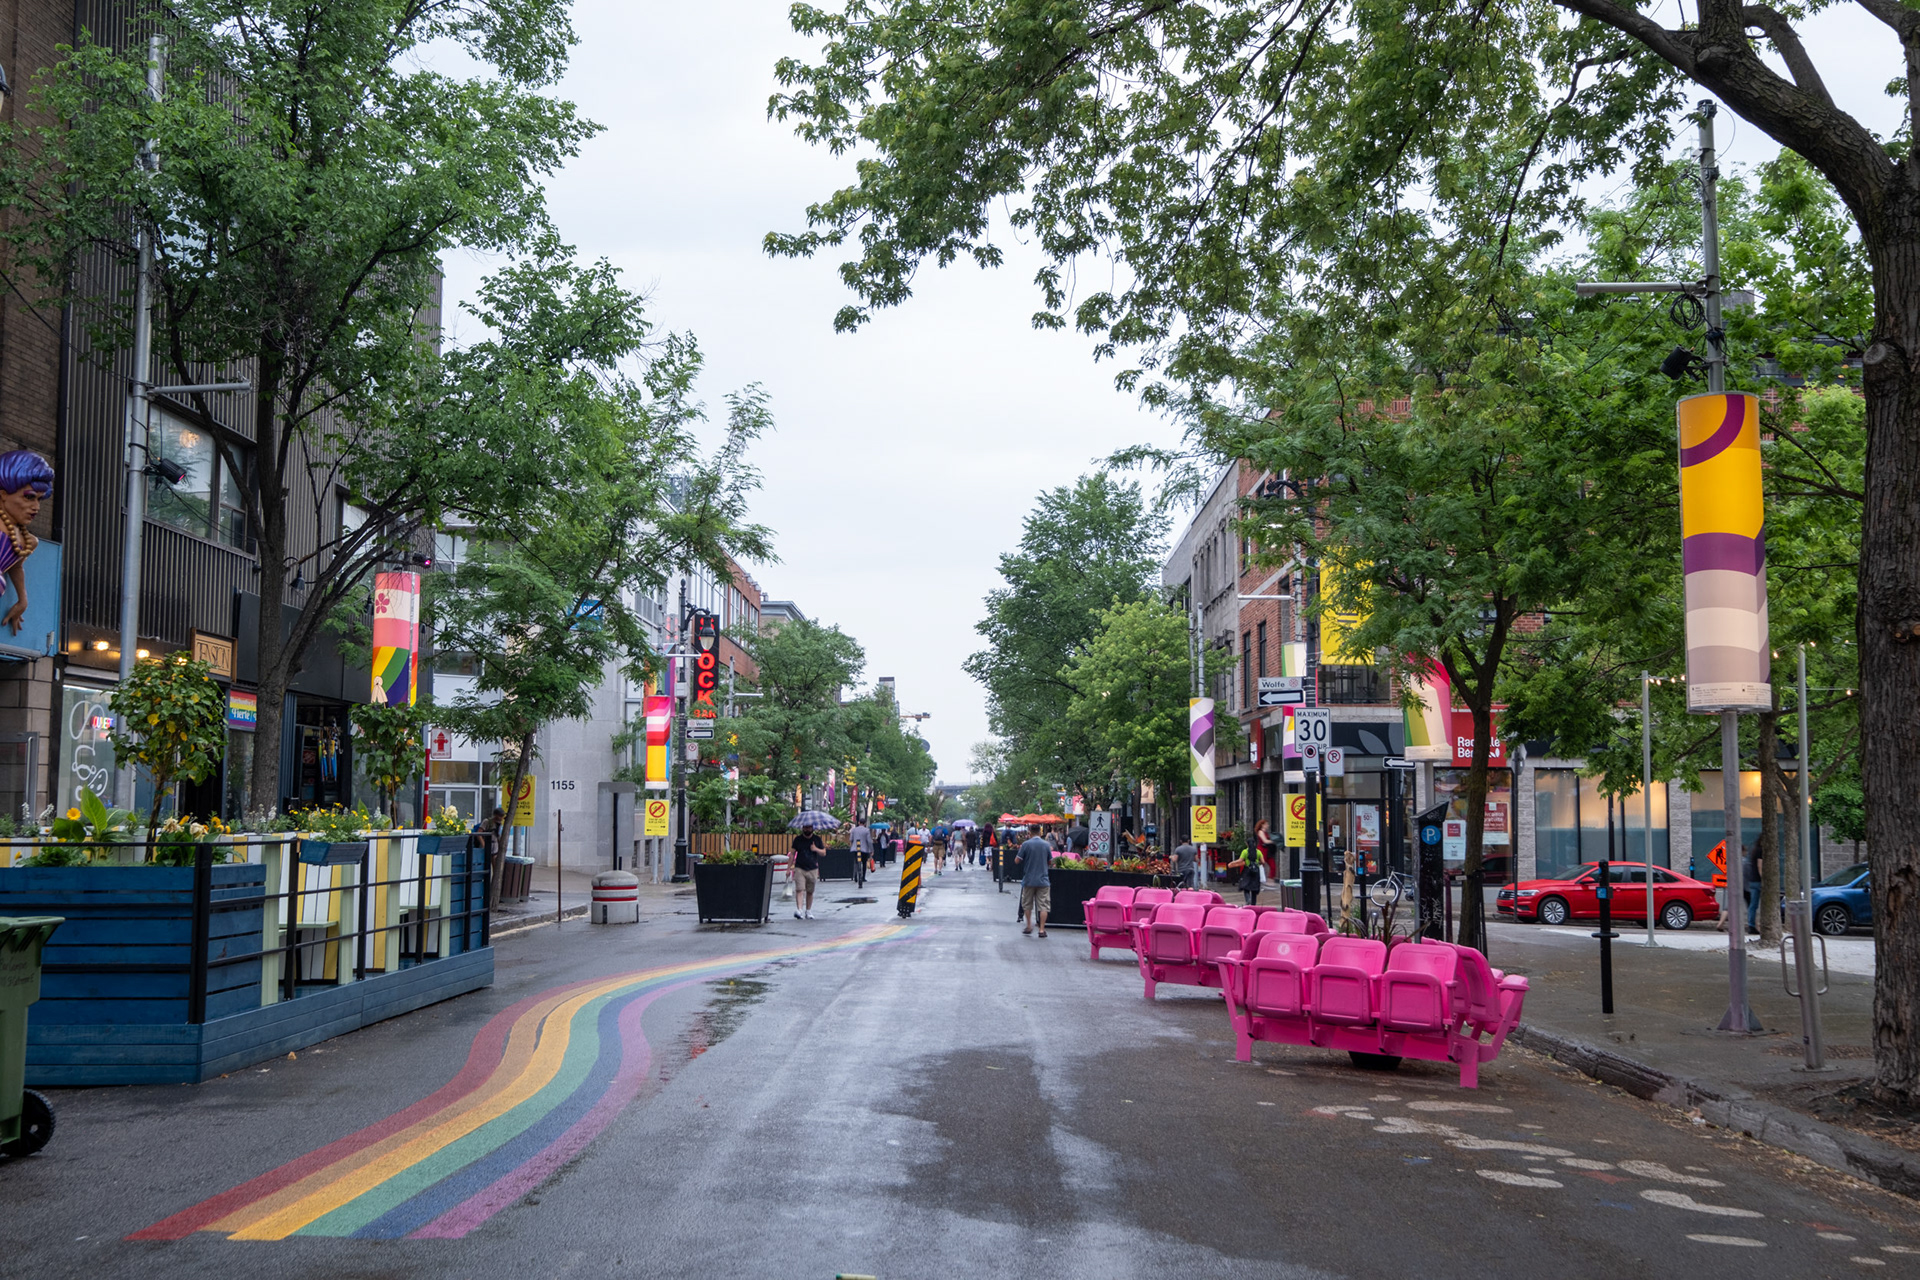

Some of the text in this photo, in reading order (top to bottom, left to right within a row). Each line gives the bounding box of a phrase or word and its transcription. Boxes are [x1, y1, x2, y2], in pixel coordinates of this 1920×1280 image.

[1299, 719, 1327, 741] 30
[1457, 736, 1500, 747] Racle
[551, 780, 575, 790] 1155
